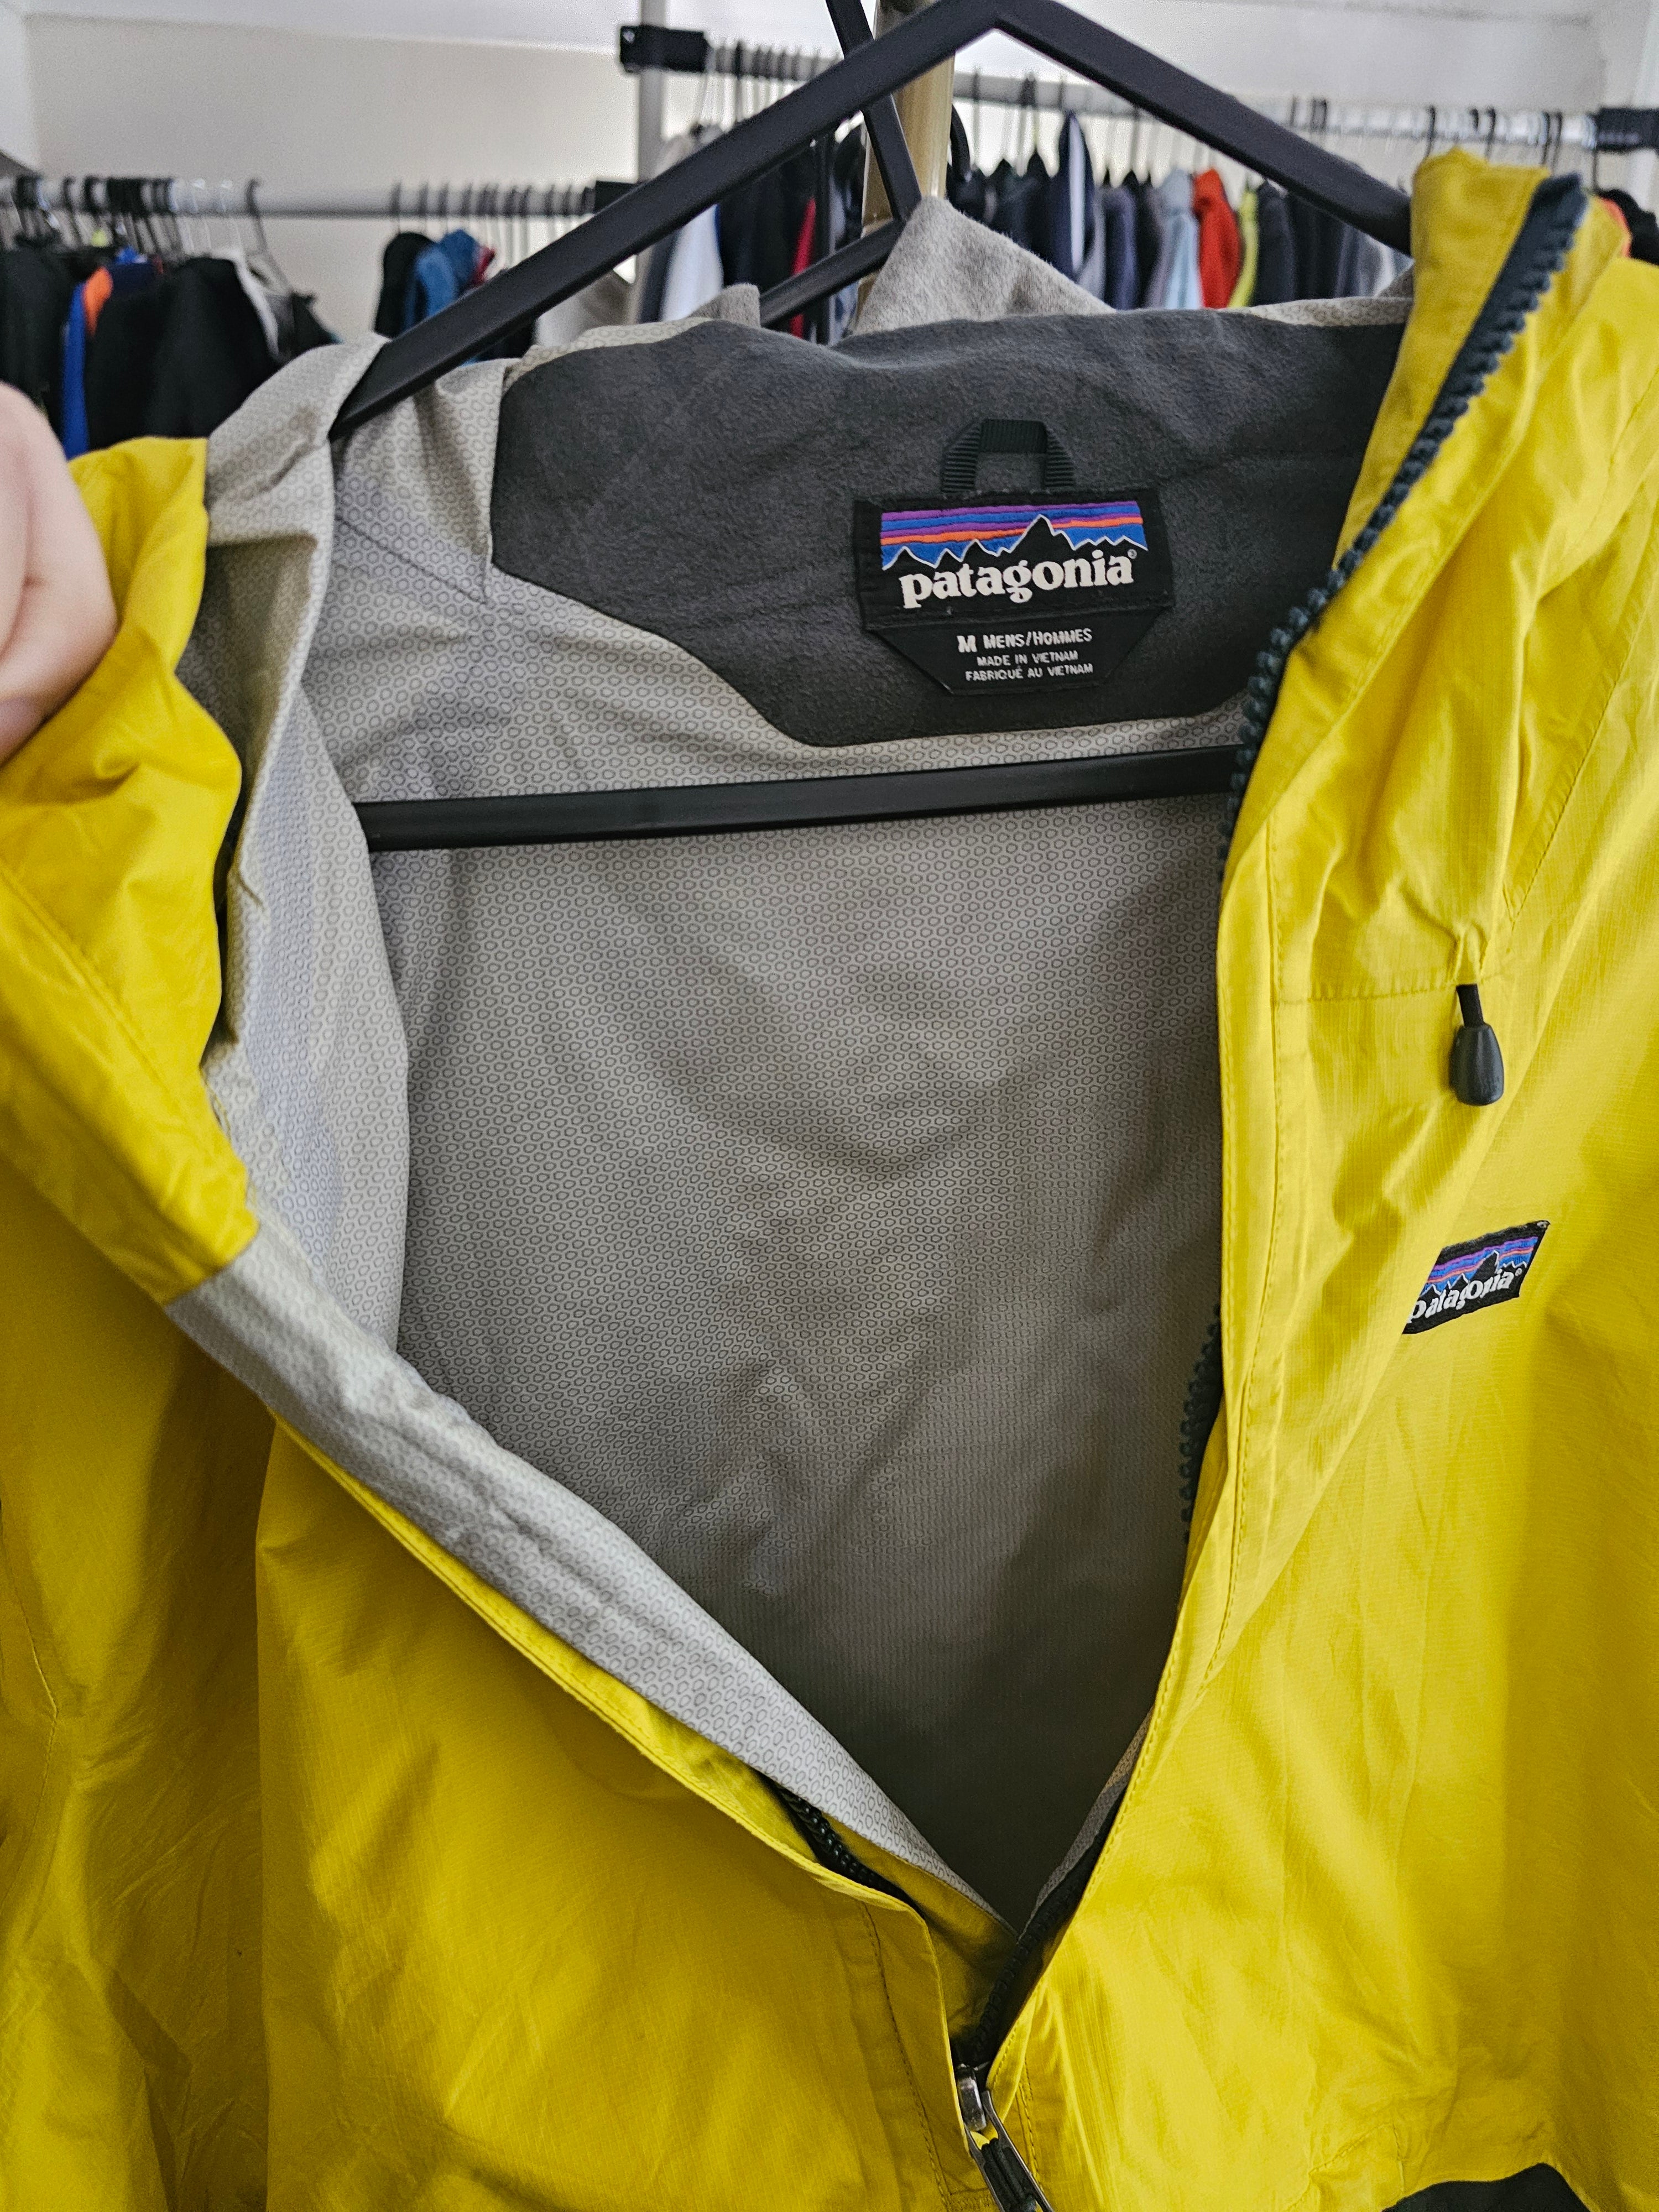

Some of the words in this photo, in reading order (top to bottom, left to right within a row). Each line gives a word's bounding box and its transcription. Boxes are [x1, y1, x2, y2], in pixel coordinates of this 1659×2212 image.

[899, 550, 1134, 609] patagonia
[957, 635, 978, 653] M
[983, 628, 1093, 649] MENS/HOMMES
[977, 654, 1010, 667] MADE
[1014, 653, 1029, 665] IN
[1031, 650, 1079, 664] VIETNAM
[1027, 667, 1044, 678] AU
[1047, 663, 1094, 677] VIETNAM
